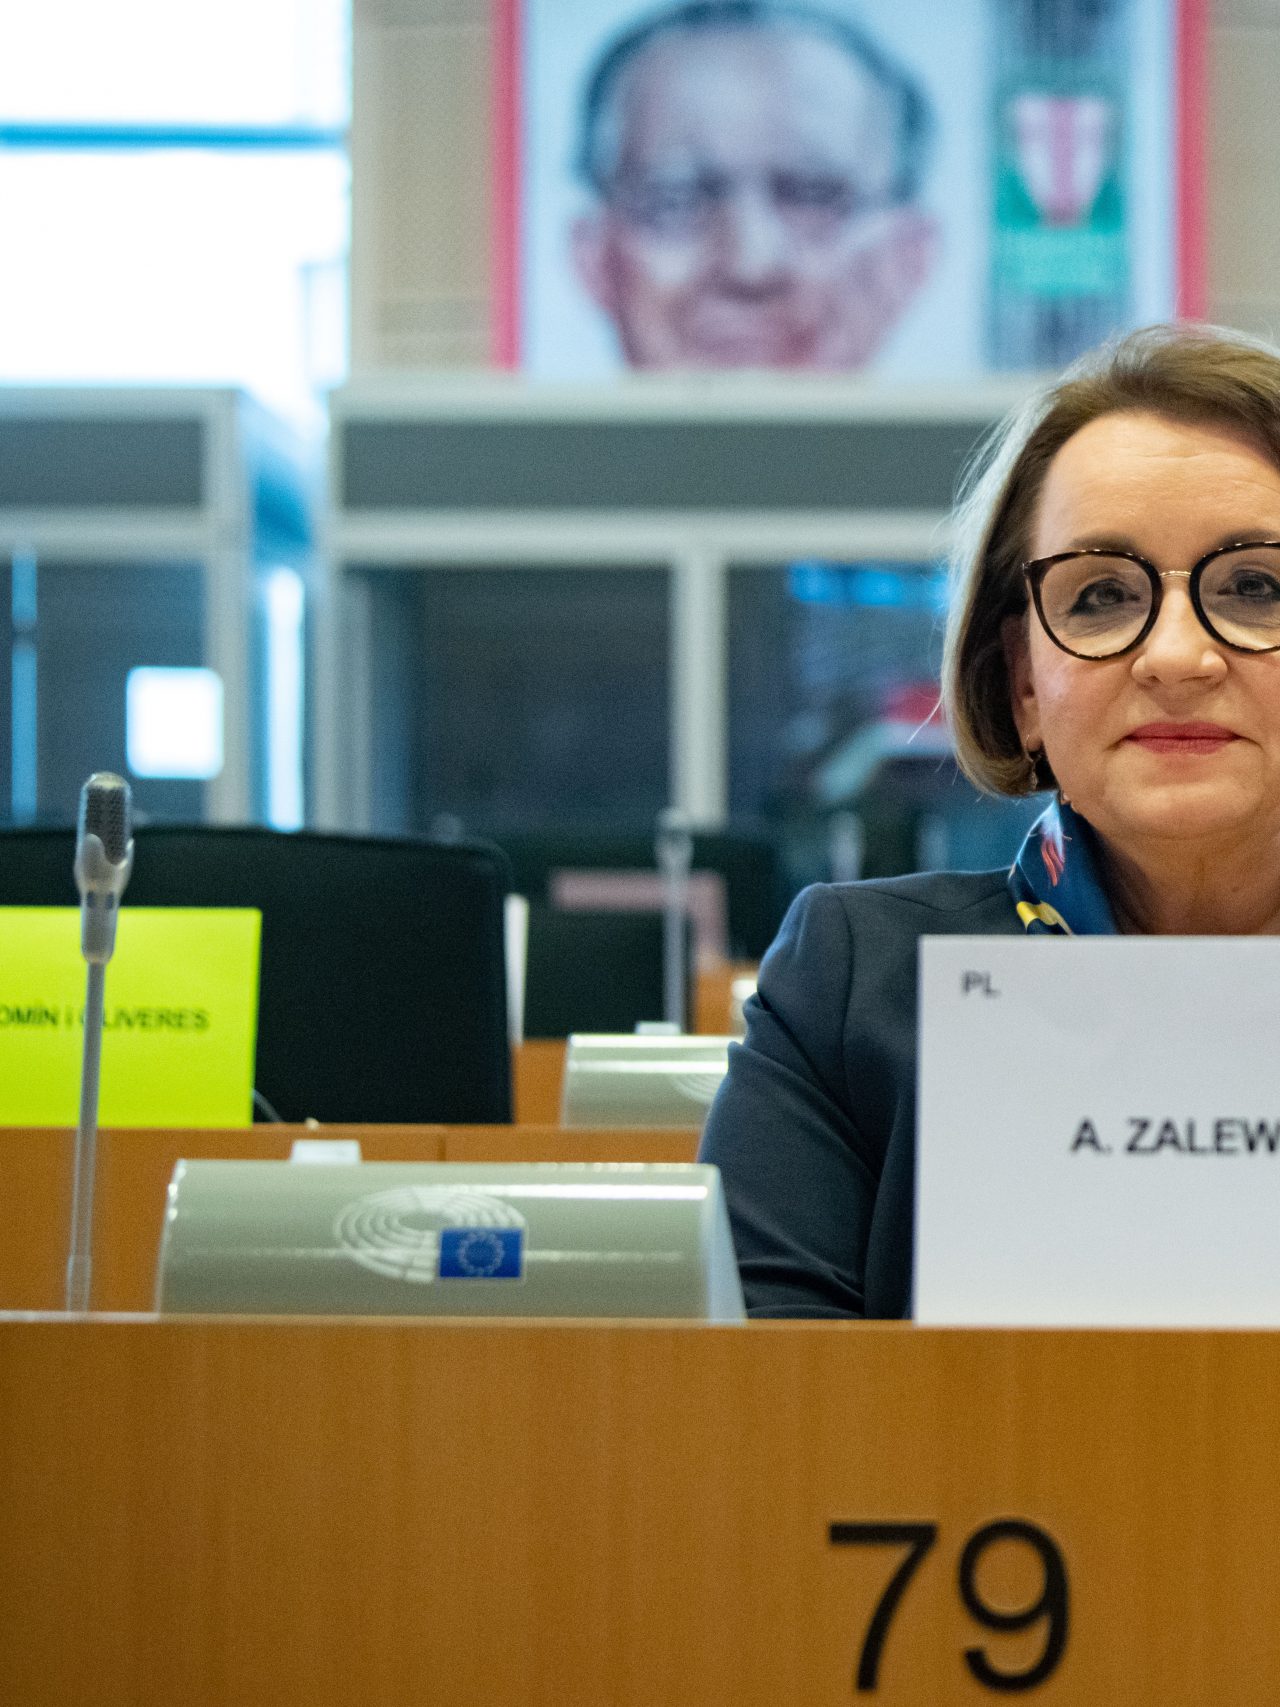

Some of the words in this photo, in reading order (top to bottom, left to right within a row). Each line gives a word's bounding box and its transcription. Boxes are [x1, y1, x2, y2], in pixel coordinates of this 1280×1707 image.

[961, 970, 1000, 997] PL
[1071, 1118, 1112, 1154] A.
[828, 1519, 1070, 1694] 79
